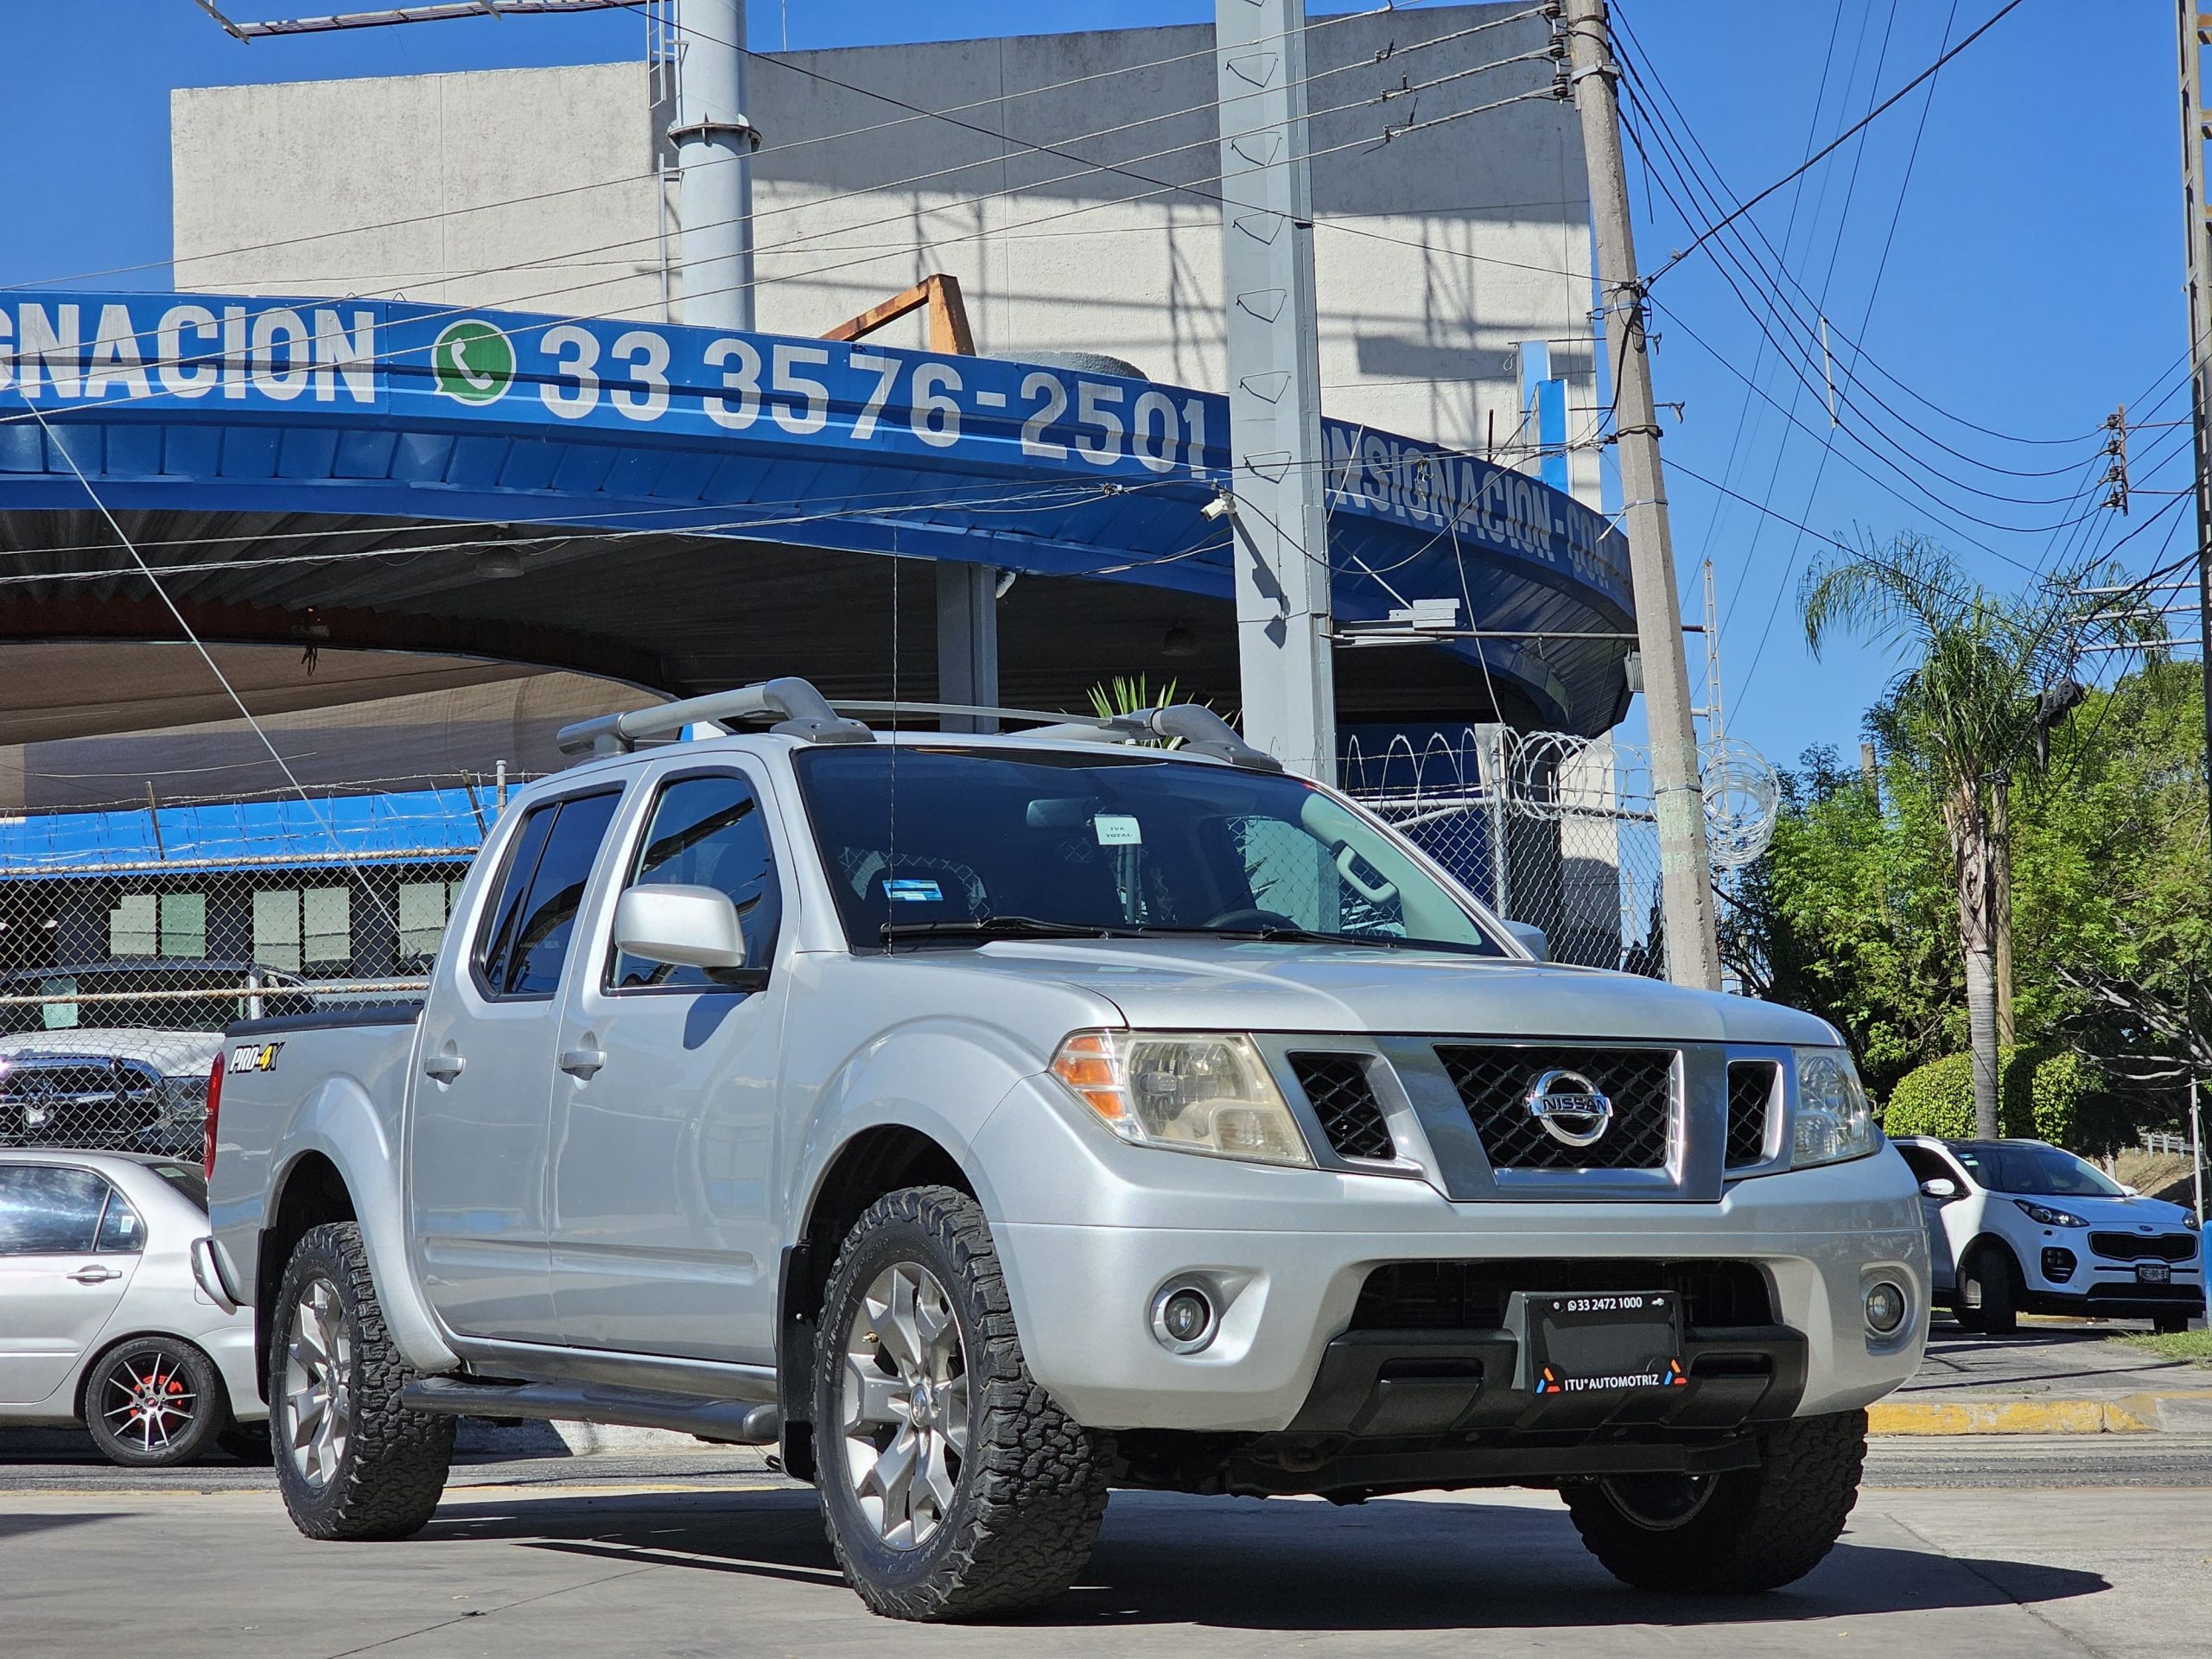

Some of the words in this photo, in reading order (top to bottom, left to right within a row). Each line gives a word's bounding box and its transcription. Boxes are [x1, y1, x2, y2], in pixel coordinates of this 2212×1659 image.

[539, 326, 671, 422] 33
[702, 337, 1207, 480] 3576-2501
[228, 1041, 286, 1074] PRO-4X
[1542, 1097, 1607, 1113] NISSAN
[1578, 1300, 1590, 1311] 33
[1592, 1298, 1617, 1310] 2472
[1618, 1297, 1643, 1308] 1000
